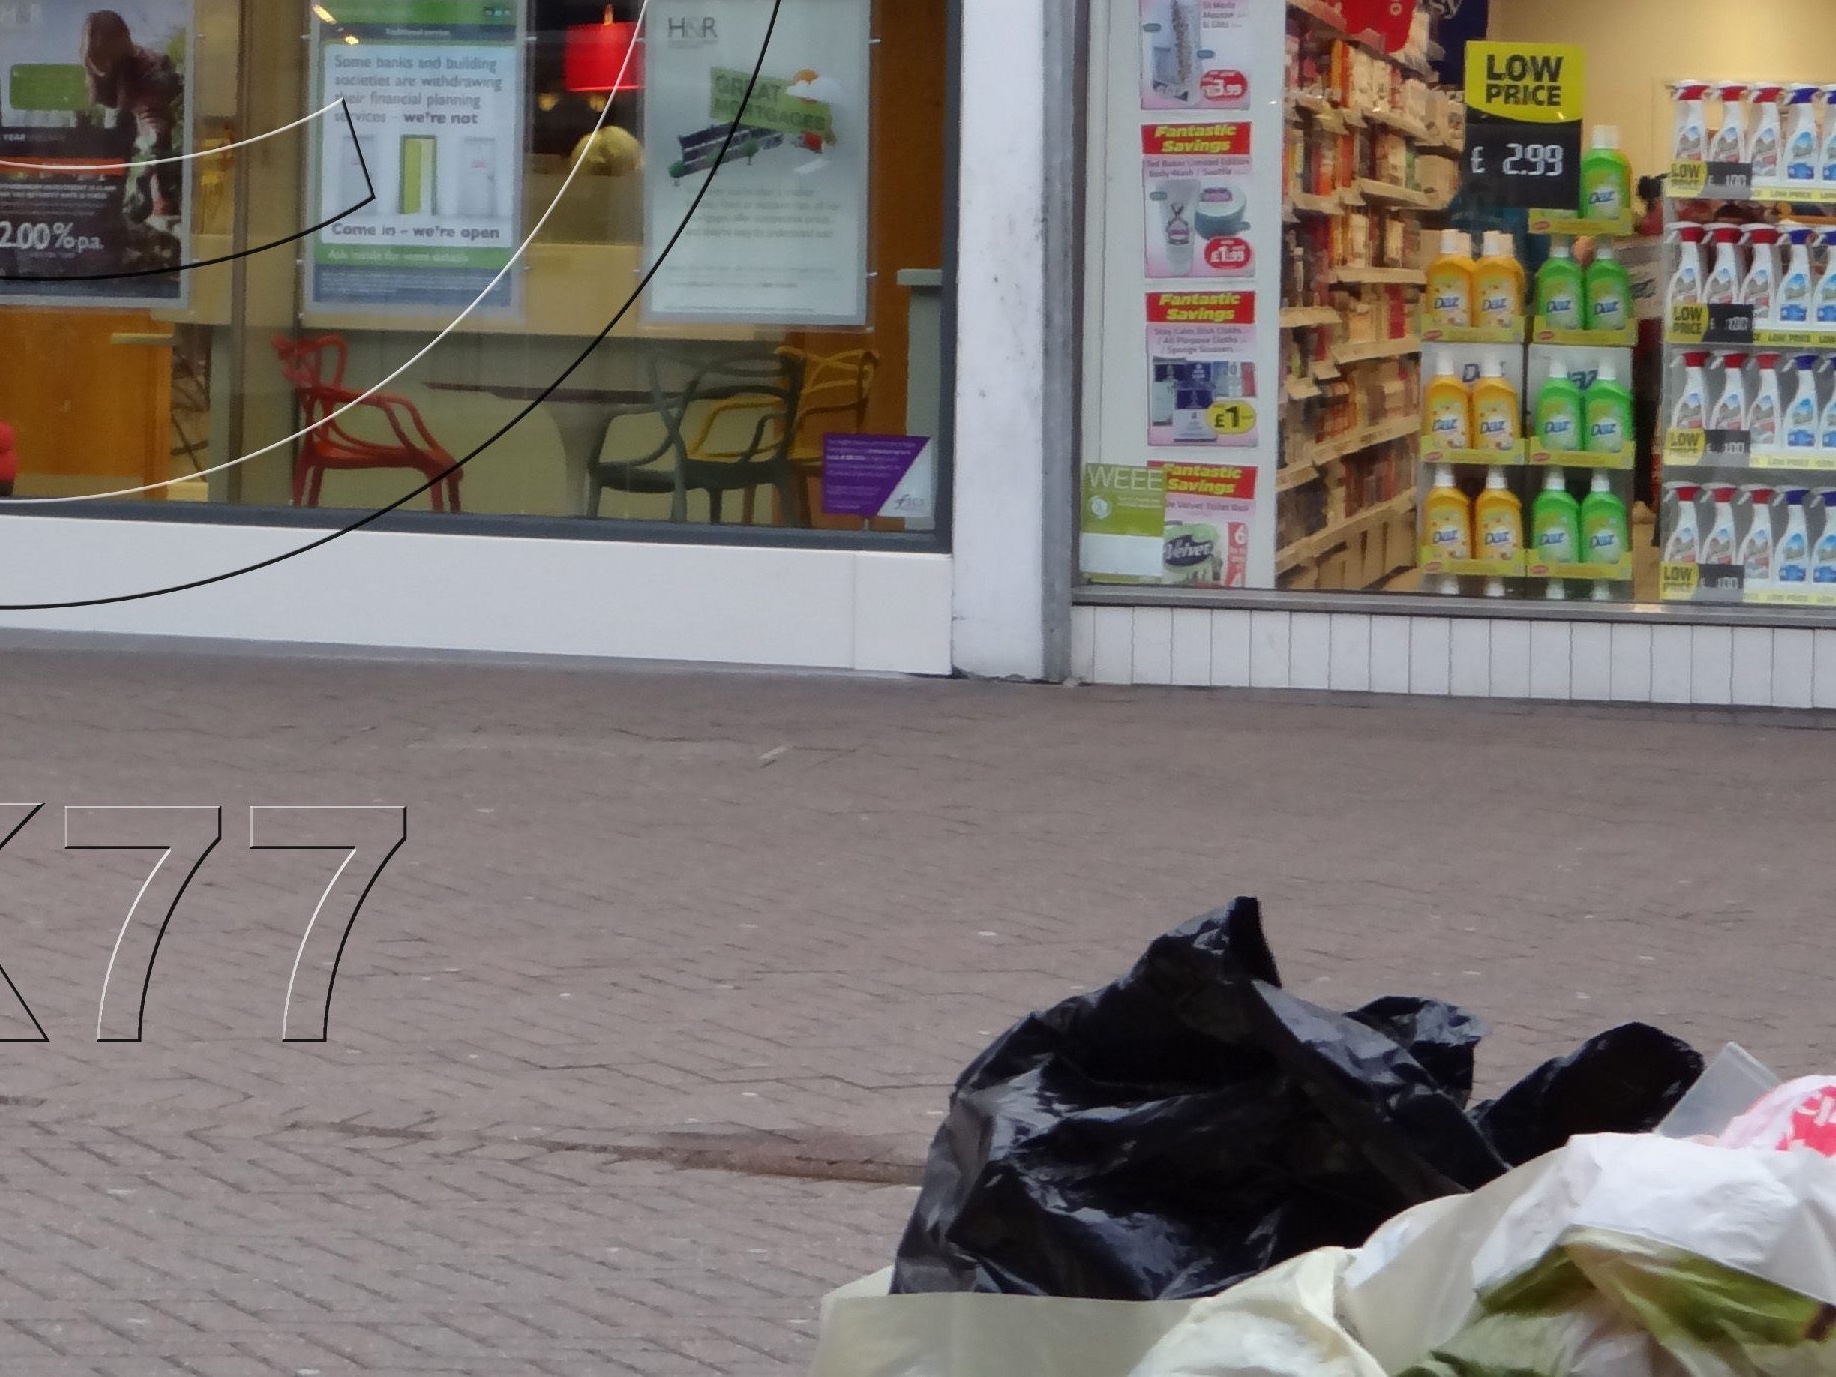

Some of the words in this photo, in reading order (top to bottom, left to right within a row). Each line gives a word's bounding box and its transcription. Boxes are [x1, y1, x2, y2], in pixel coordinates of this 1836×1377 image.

[334, 54, 372, 68] Some
[376, 54, 413, 69] banks
[417, 56, 442, 69] and
[446, 56, 497, 73] building
[1486, 54, 1564, 83] LOW
[334, 74, 391, 87] societies
[395, 77, 416, 87] are
[421, 75, 503, 92] withdrawing
[370, 91, 422, 105] financial
[426, 93, 481, 109] planning
[1485, 84, 1562, 106] PRICE
[334, 111, 386, 123] services
[404, 110, 447, 124] we're
[450, 111, 480, 124] not
[1155, 123, 1237, 138] Fantastic
[1162, 138, 1231, 153] Savings
[1470, 146, 1485, 174] £
[1502, 143, 1564, 176] 2.99
[1671, 162, 1701, 178] LOW
[331, 223, 377, 236] Come
[381, 223, 396, 236] in
[413, 225, 456, 237] we're
[460, 227, 500, 241] open
[1159, 292, 1241, 306] Fantastic
[1434, 296, 1460, 310] Daz
[1483, 297, 1508, 312] Daz
[1546, 299, 1572, 313] Daz
[1166, 307, 1235, 322] Savings
[1594, 301, 1619, 315] Daz
[1673, 305, 1702, 321] LOW
[1432, 418, 1459, 432] Daz
[1480, 420, 1506, 434] Daz
[1545, 420, 1571, 434] Daz
[1591, 423, 1617, 437] Daz
[1671, 432, 1699, 446] LOW
[1088, 465, 1163, 491] WEEE
[1167, 478, 1236, 495] Savings
[1432, 529, 1459, 544] Daz
[1484, 531, 1510, 545] Daz
[1540, 532, 1565, 546] Daz
[1590, 535, 1615, 548] Daz
[1664, 567, 1693, 581] LOW
